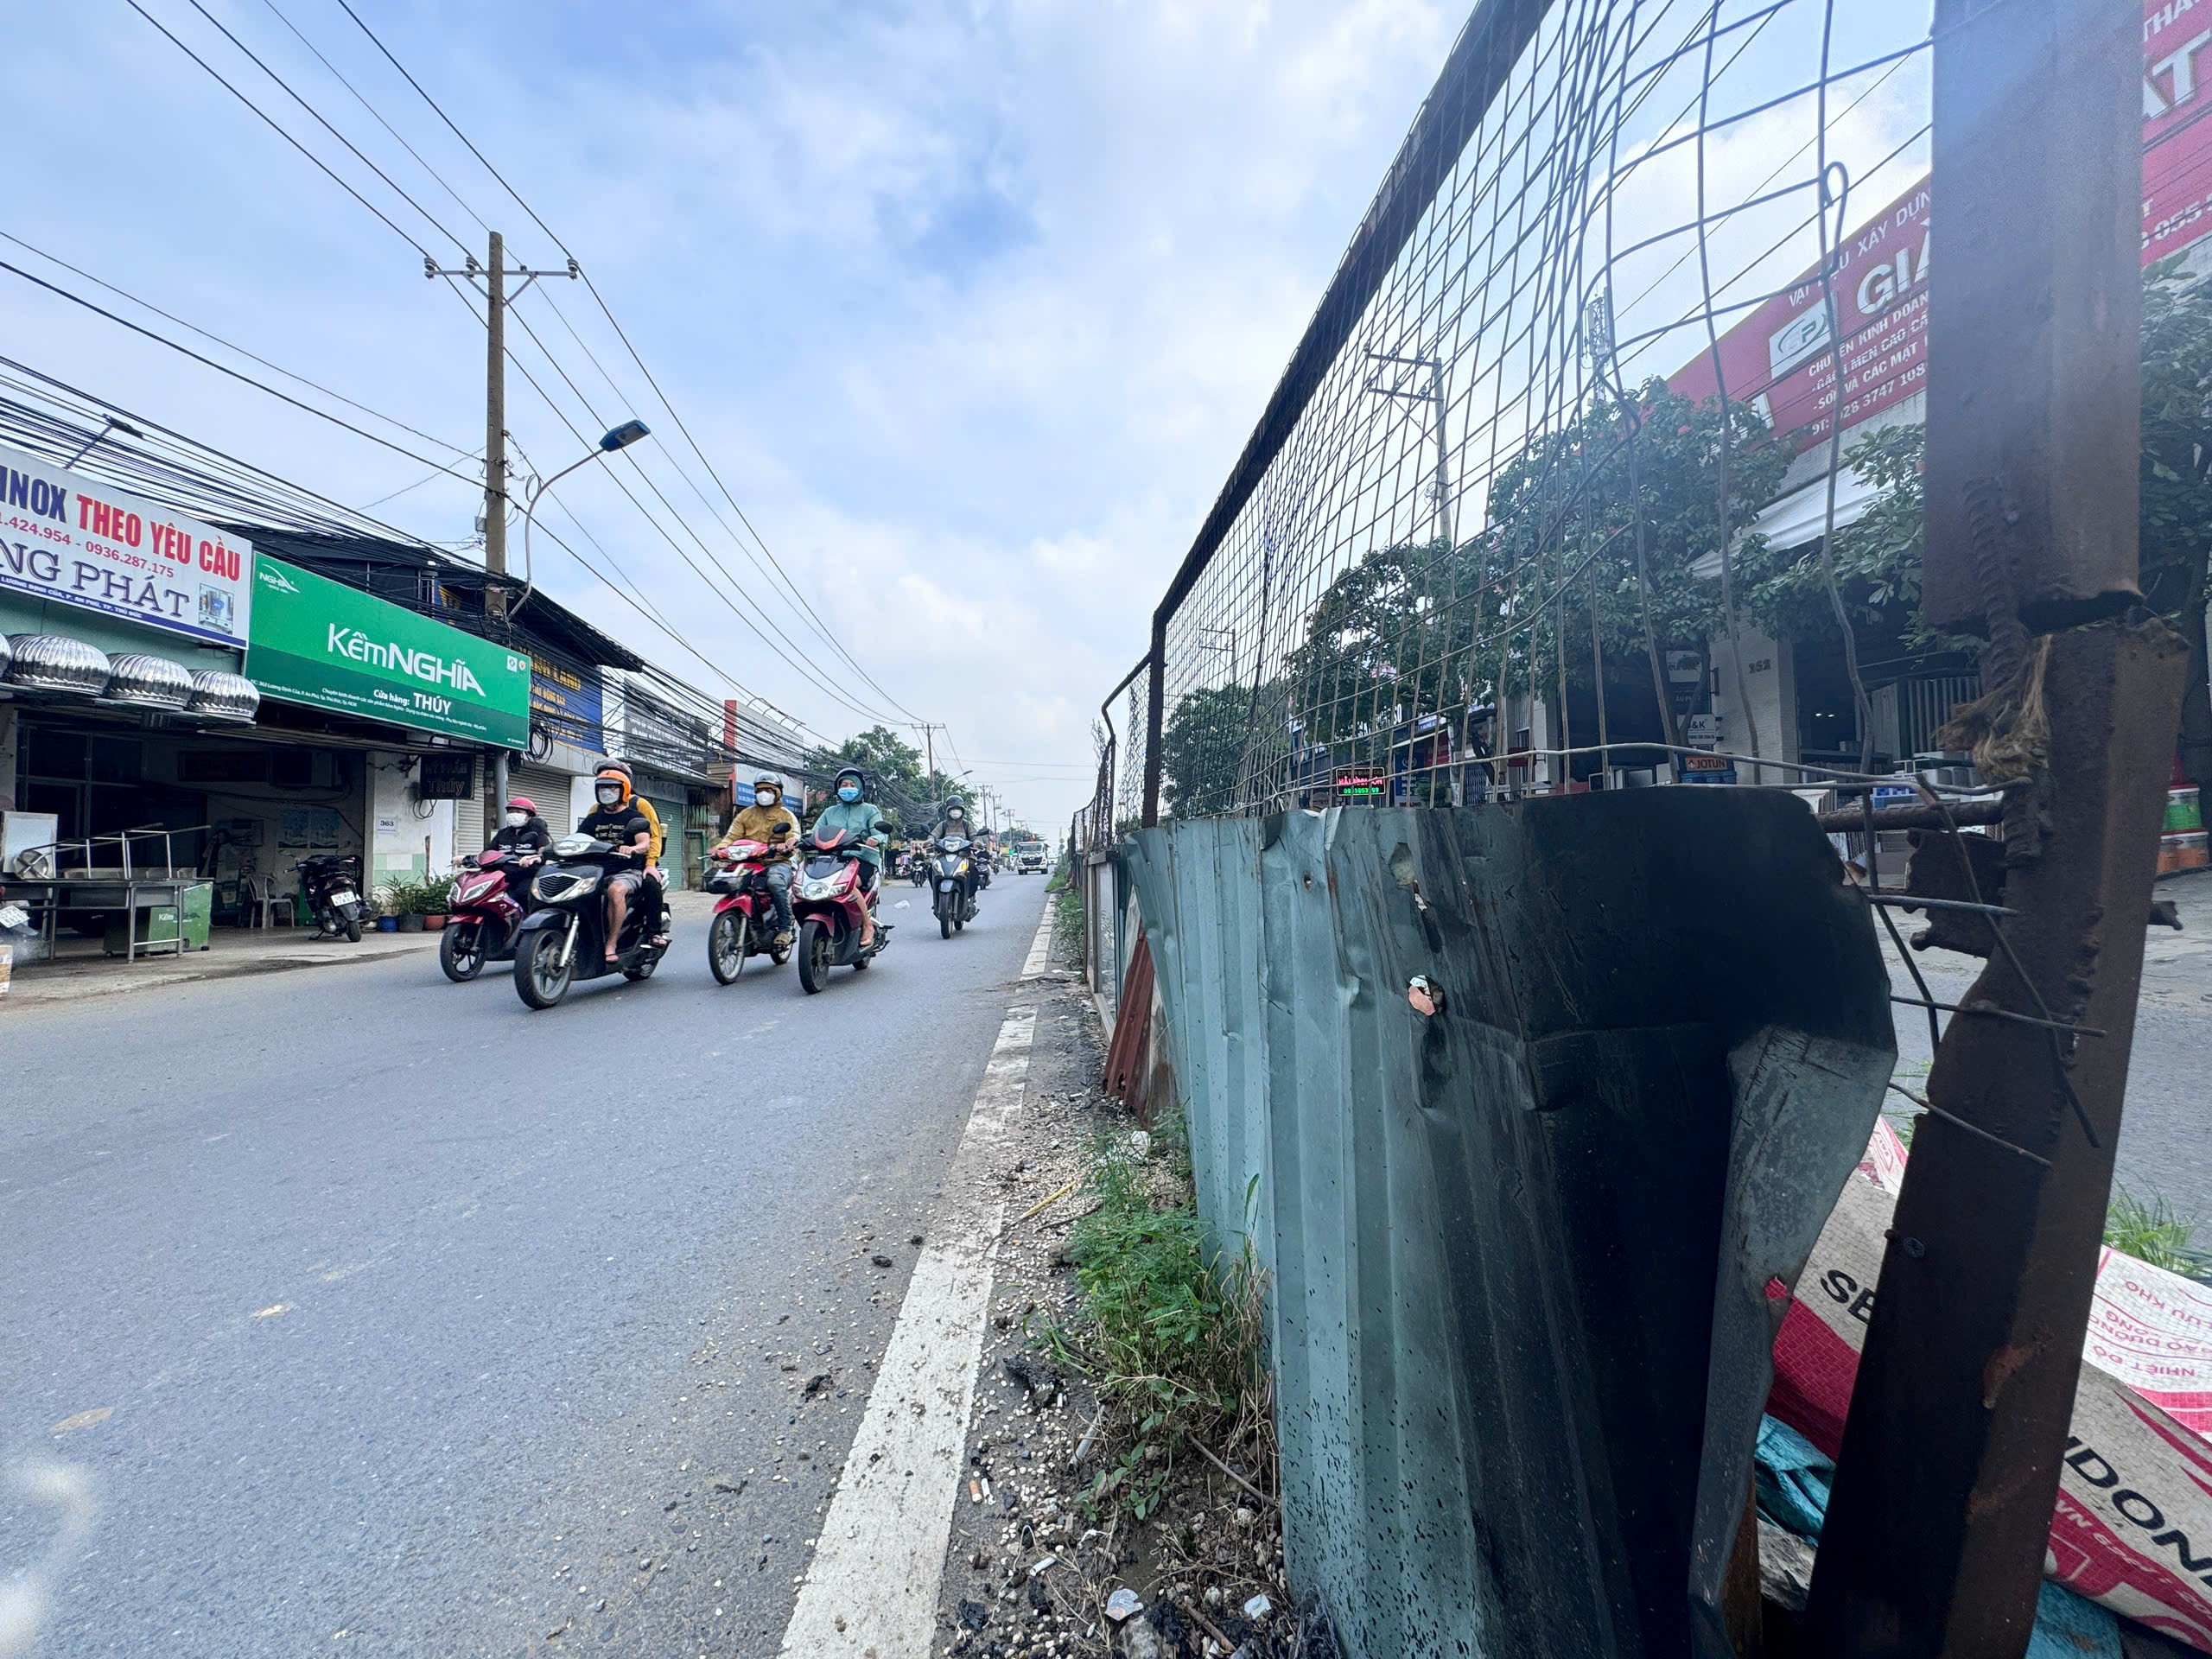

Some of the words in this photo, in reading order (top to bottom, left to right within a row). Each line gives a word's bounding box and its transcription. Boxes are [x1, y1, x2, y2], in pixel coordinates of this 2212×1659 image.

[1858, 220, 1887, 257] XÂY
[1896, 191, 1930, 227] DỰN
[1809, 340, 1854, 377] CHUÊN
[1859, 317, 1888, 346] KINH
[1892, 290, 1929, 325] DOAN
[1851, 346, 1878, 371] MEN
[1881, 327, 1906, 352] CAO
[1863, 359, 1887, 383] CÁC
[1862, 378, 1895, 408] 3747
[0, 465, 67, 524] INOX
[76, 493, 142, 548] THEO
[150, 521, 192, 565] YÊU
[199, 535, 241, 582] CẦU
[86, 540, 175, 578] 0936.287.175
[71, 560, 190, 619] PHÁT
[1697, 759, 1726, 769] JOTUN
[2126, 1281, 2166, 1310] KHO
[2093, 1344, 2124, 1364] ĐỘ
[2131, 1362, 2196, 1377] NHIỆT
